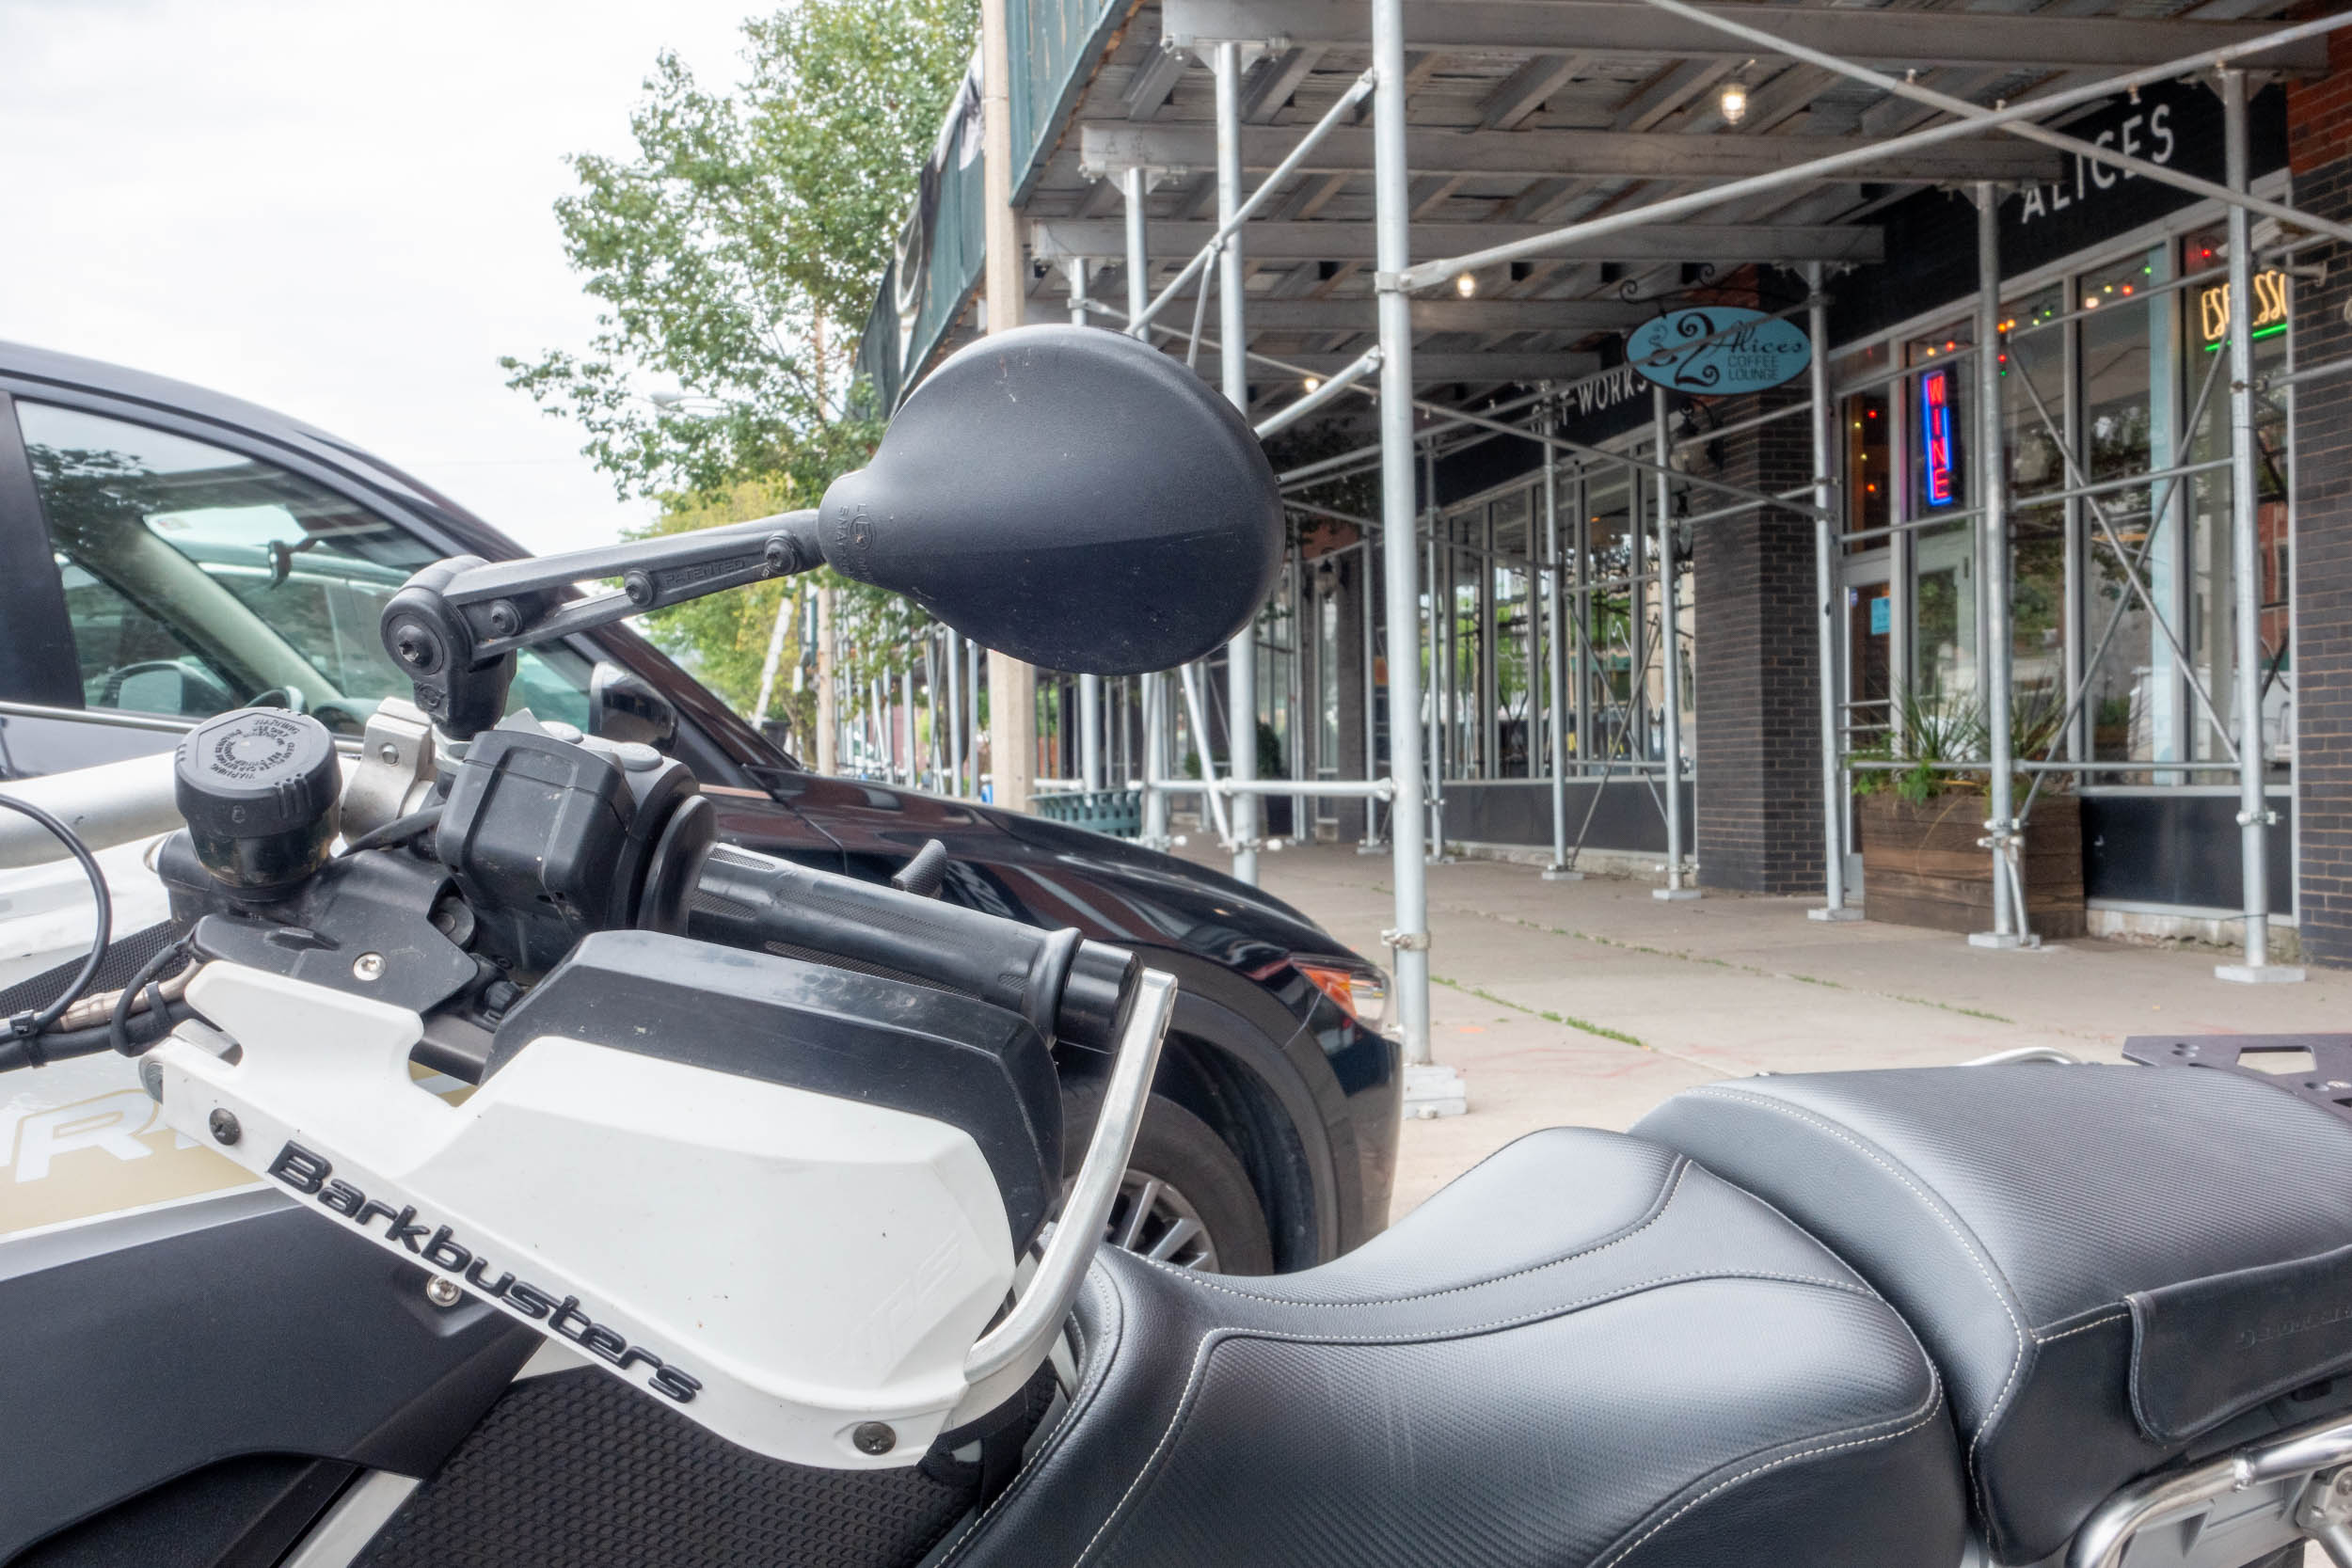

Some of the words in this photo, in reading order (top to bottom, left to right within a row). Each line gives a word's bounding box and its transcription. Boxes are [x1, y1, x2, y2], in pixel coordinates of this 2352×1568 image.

[2021, 103, 2174, 224] ALICES
[2201, 269, 2289, 341] ESPSS
[1708, 320, 1804, 358] Alices
[1727, 355, 1780, 368] COFFEE
[1727, 368, 1779, 381] LOUNGE
[1926, 375, 1950, 499] WINE
[660, 558, 745, 588] PATENTED
[266, 1139, 703, 1403] Barkbusters
